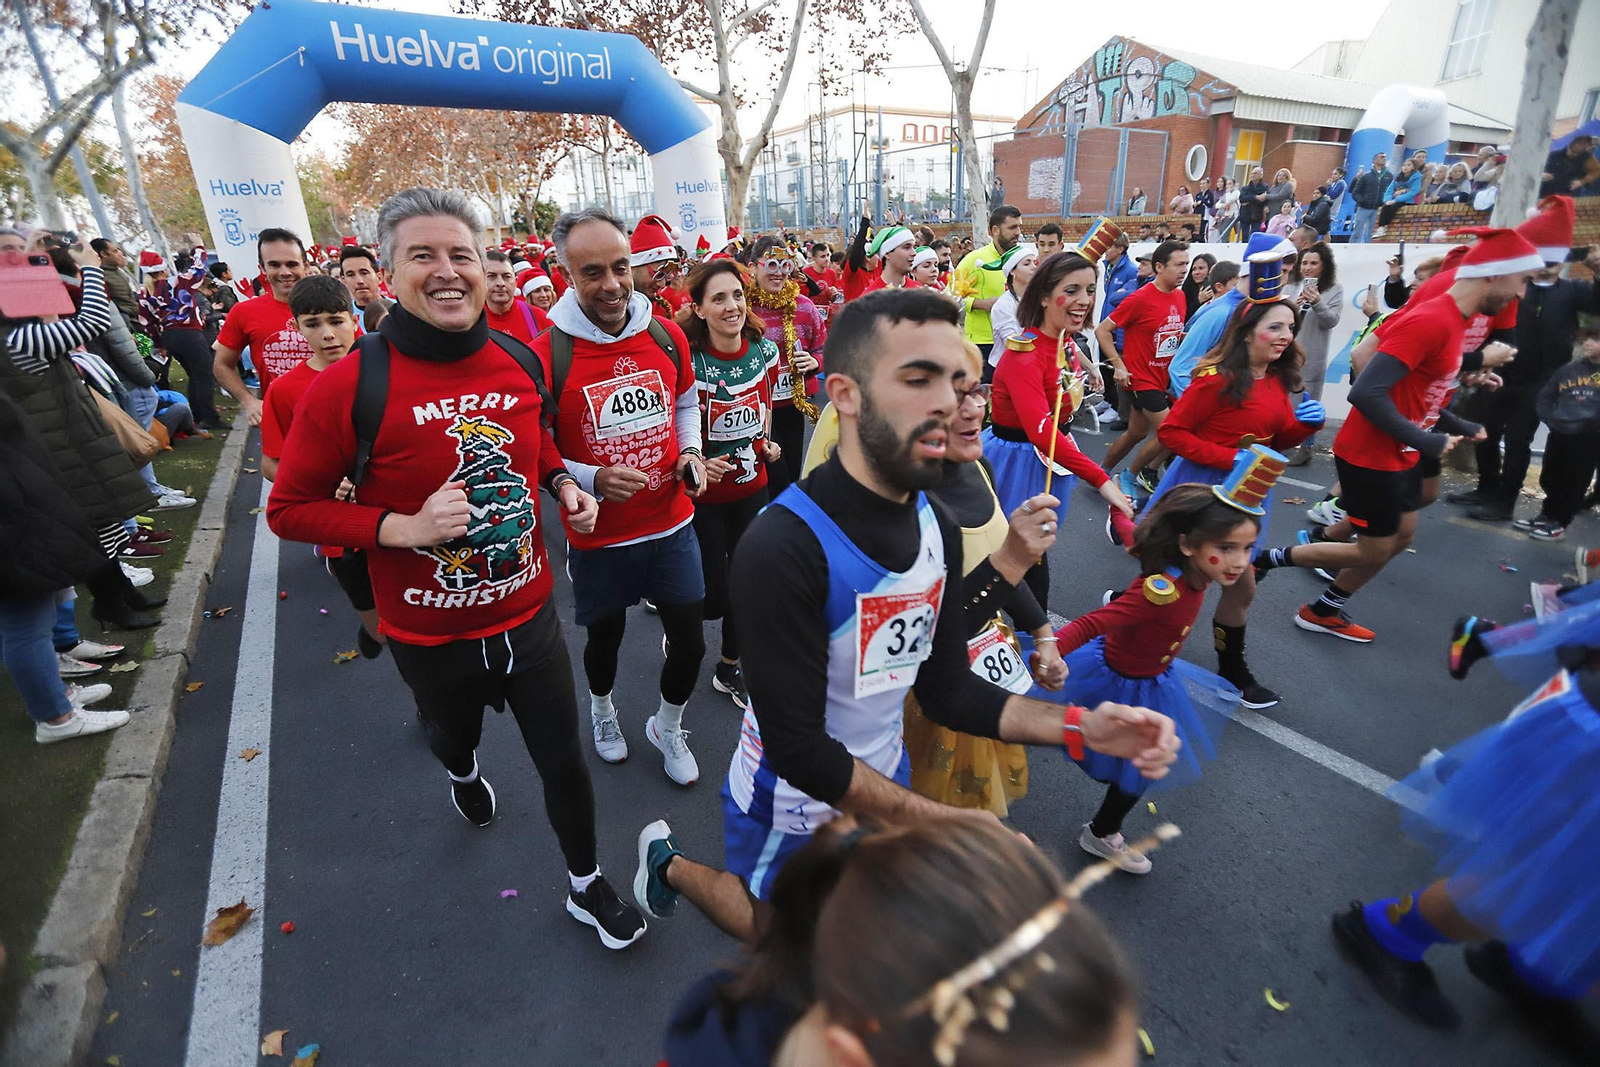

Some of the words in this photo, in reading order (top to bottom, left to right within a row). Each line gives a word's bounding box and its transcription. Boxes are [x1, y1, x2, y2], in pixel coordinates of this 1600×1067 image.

[329, 21, 489, 71] Huelva
[493, 39, 612, 85] original
[209, 178, 284, 196] Huelva
[675, 179, 719, 195] Huelva
[264, 341, 313, 351] CARRE
[412, 392, 519, 426] MERRY
[611, 388, 649, 417] 488
[723, 407, 751, 428] 570
[609, 445, 663, 469] 2023
[403, 555, 542, 608] CHRISTMAS
[983, 647, 1013, 683] 86
